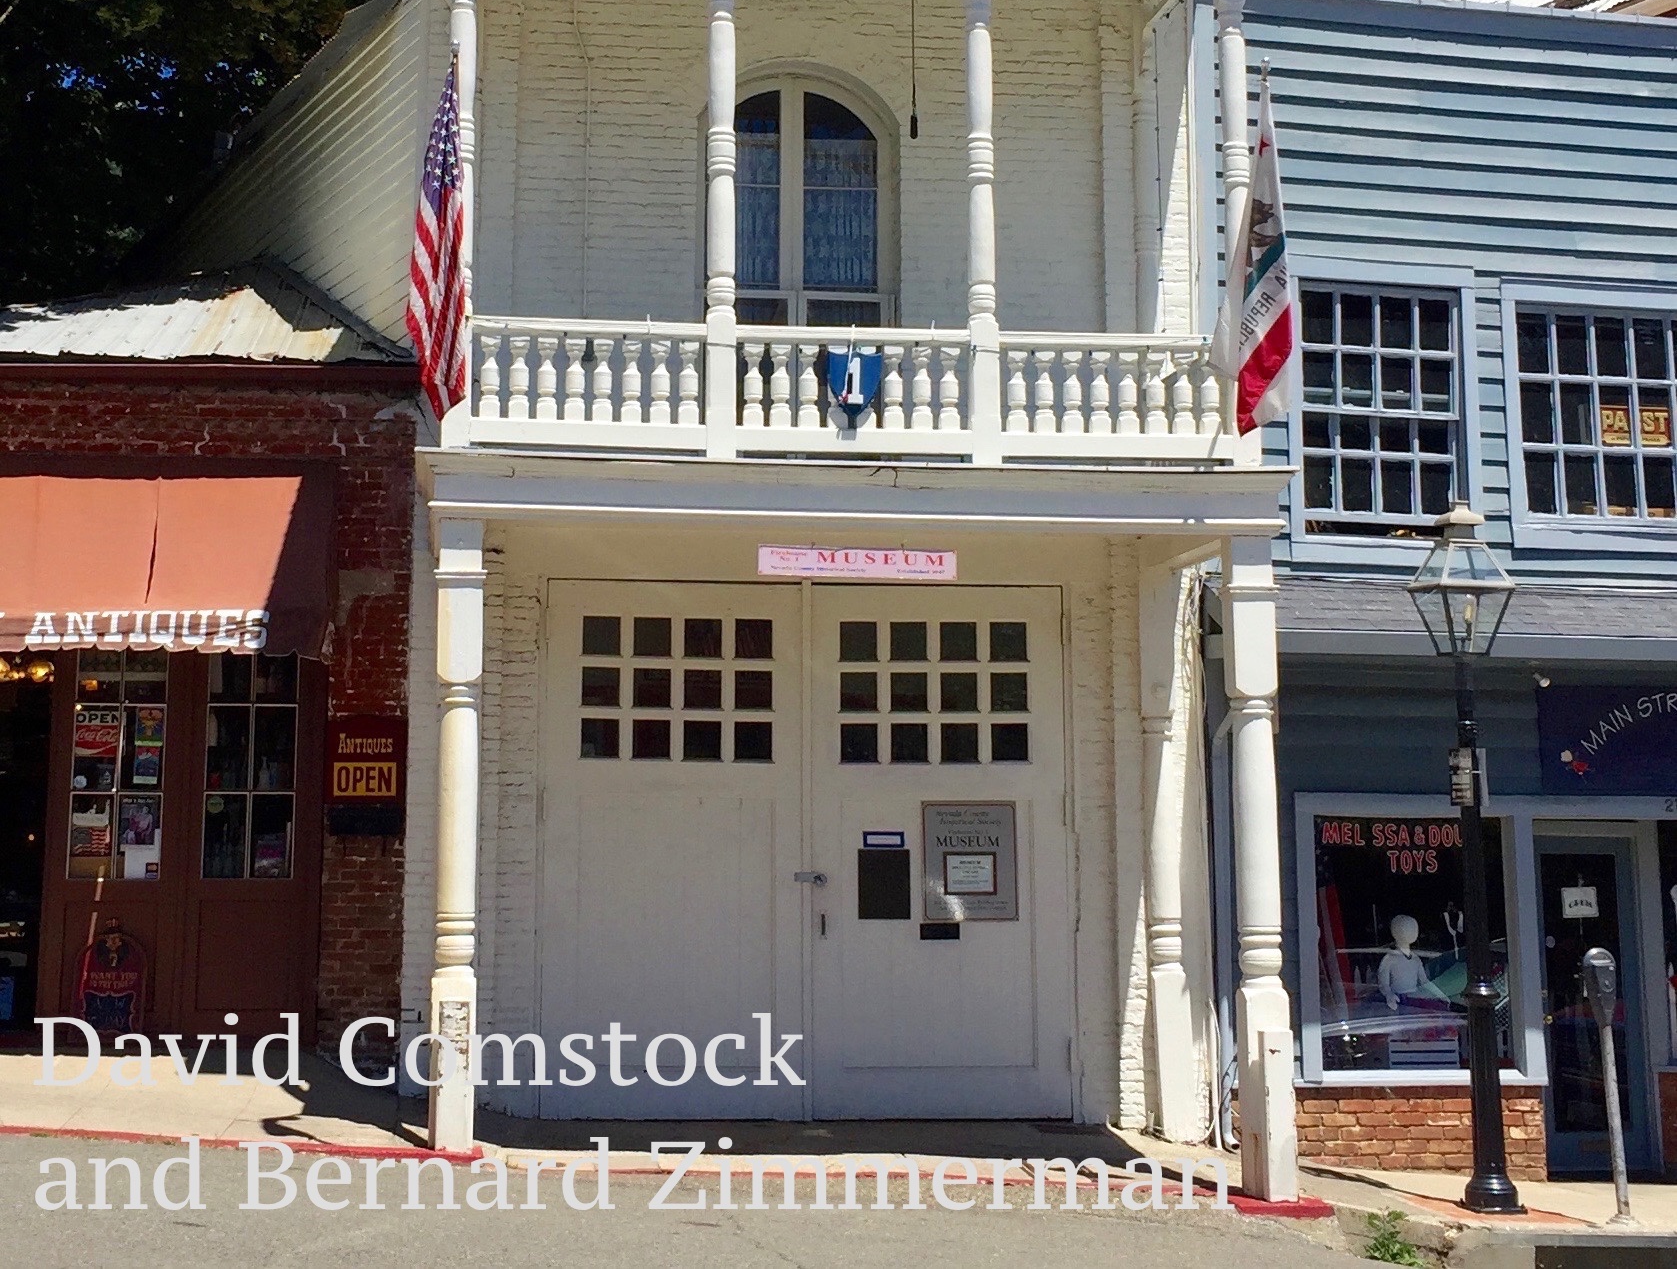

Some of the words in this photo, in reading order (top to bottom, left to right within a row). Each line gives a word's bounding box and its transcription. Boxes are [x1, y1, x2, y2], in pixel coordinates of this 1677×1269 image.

[817, 551, 945, 567] MUSEUM
[25, 609, 270, 649] ANTIQUES
[76, 712, 119, 724] OPEN
[1580, 703, 1634, 756] MAIN
[337, 732, 394, 756] ANTIQUES
[336, 765, 394, 794] OPEN
[935, 835, 1000, 848] MUSEUM
[1413, 825, 1426, 846] &
[1428, 824, 1463, 848] DOU
[1386, 849, 1439, 874] TOYS
